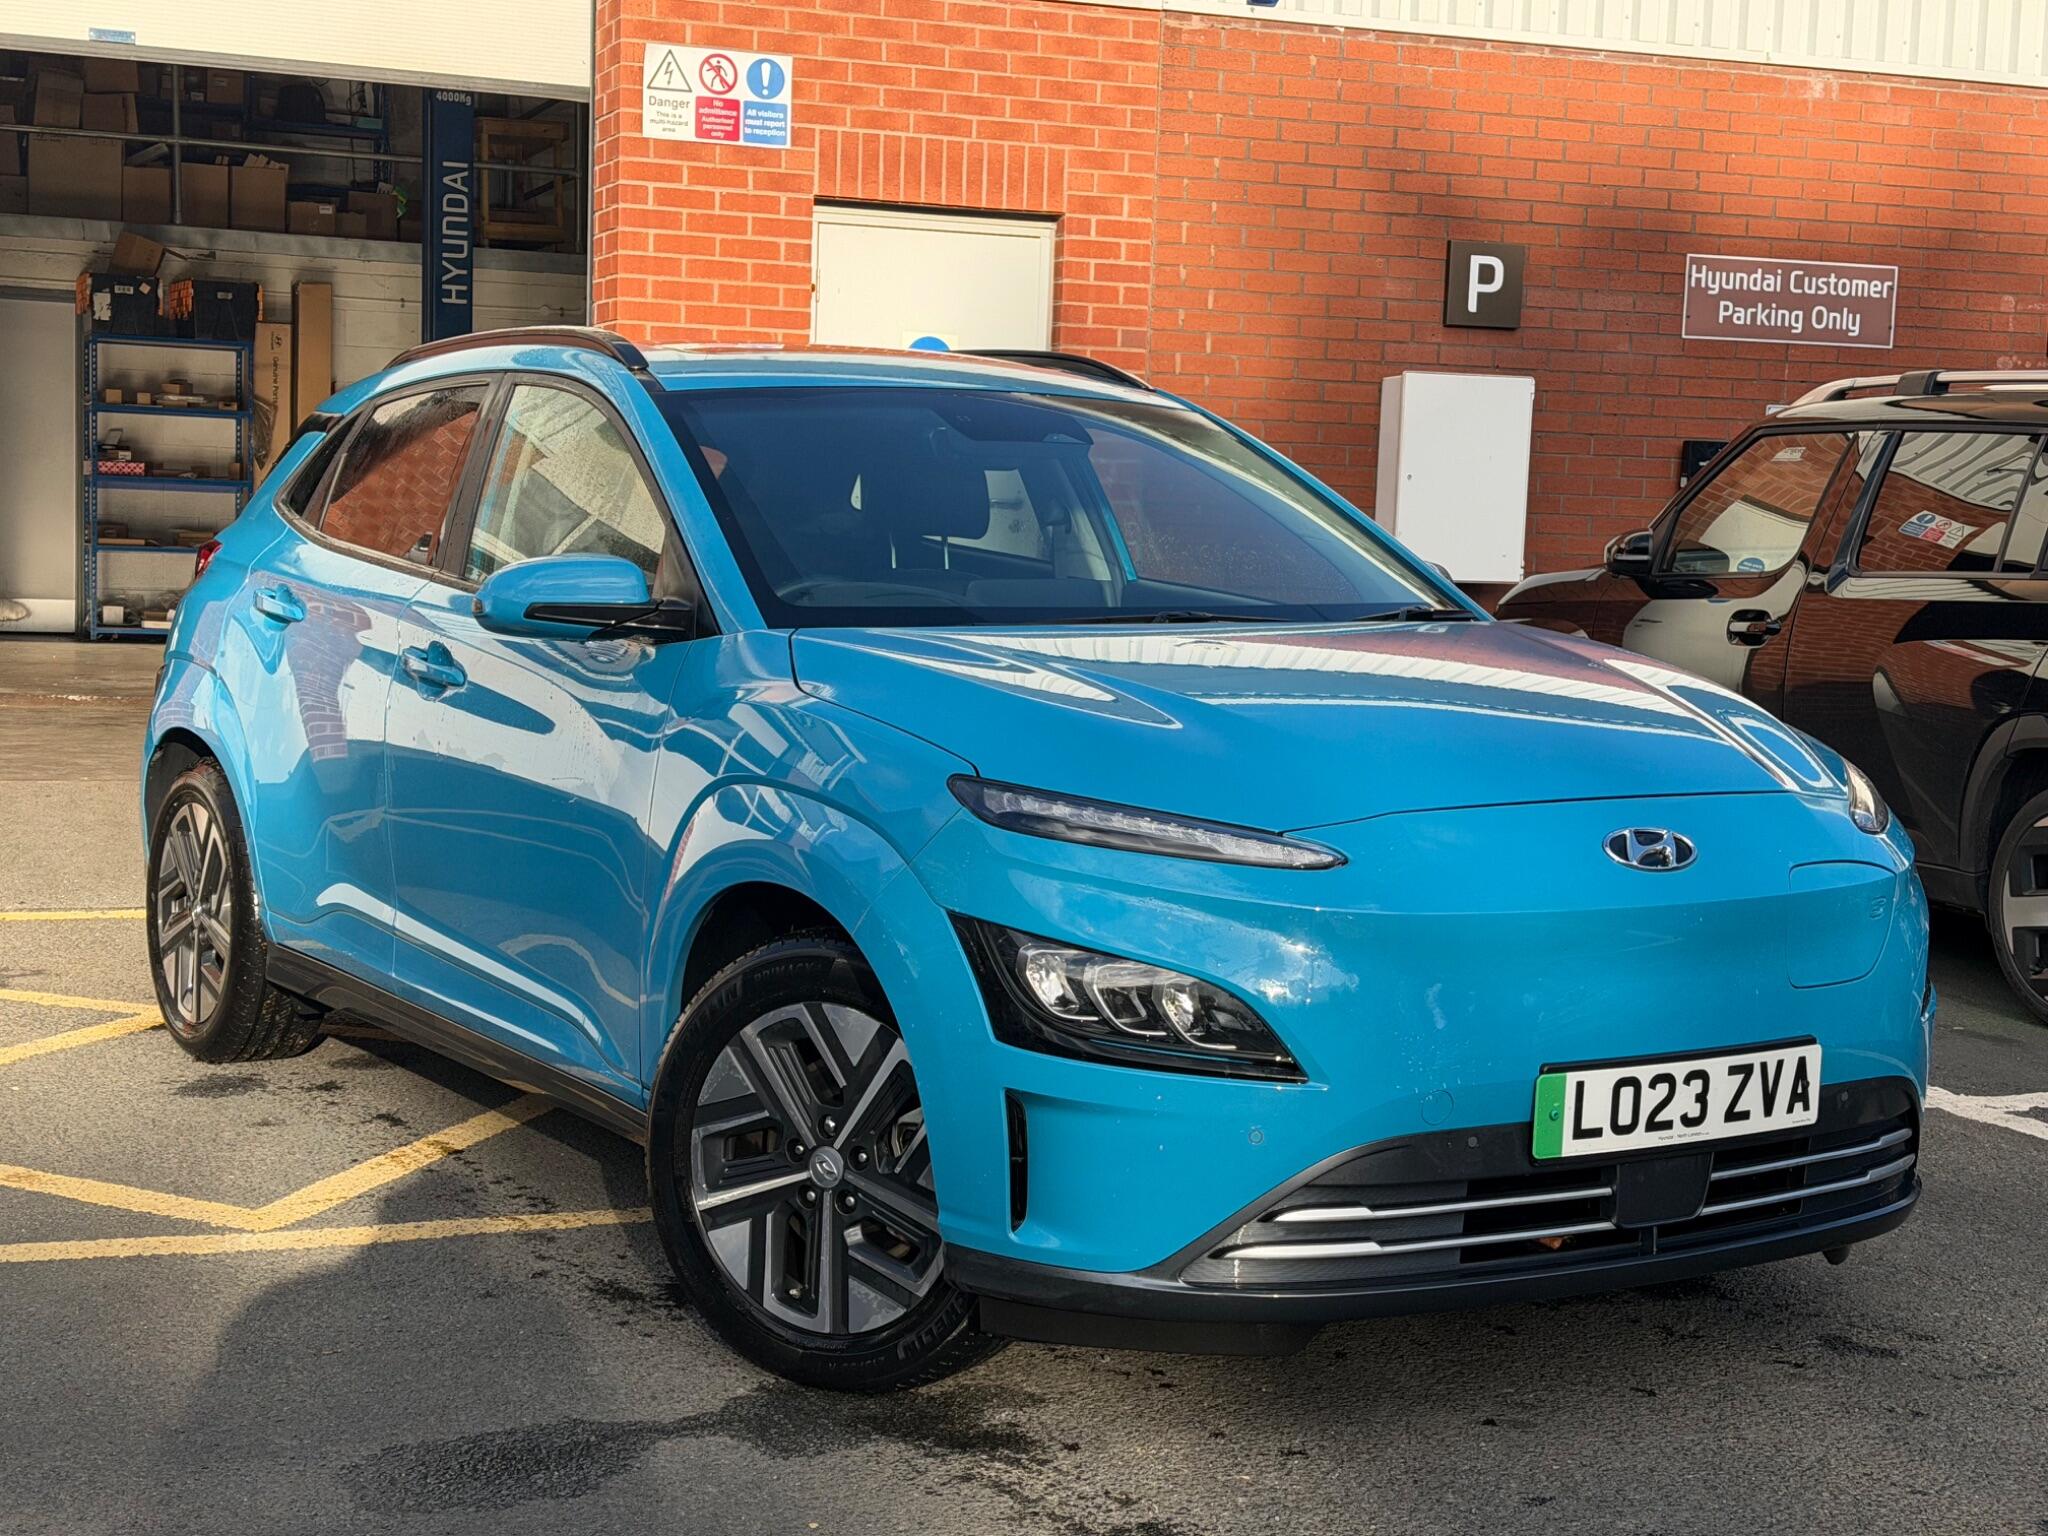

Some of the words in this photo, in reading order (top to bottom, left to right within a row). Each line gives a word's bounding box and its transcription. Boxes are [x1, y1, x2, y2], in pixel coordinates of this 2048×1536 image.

[648, 95, 690, 110] Danger
[758, 110, 784, 118] visitors
[753, 128, 786, 136] reception
[764, 120, 786, 128] report
[441, 161, 469, 305] HYUNDAI
[1467, 254, 1505, 313] P
[1690, 264, 1782, 296] Hyundai
[1790, 270, 1893, 298] Customer
[1718, 300, 1804, 334] Parking
[1811, 305, 1861, 337] Only
[1572, 1068, 1711, 1140] LO23
[1724, 1056, 1811, 1124] ZVA
